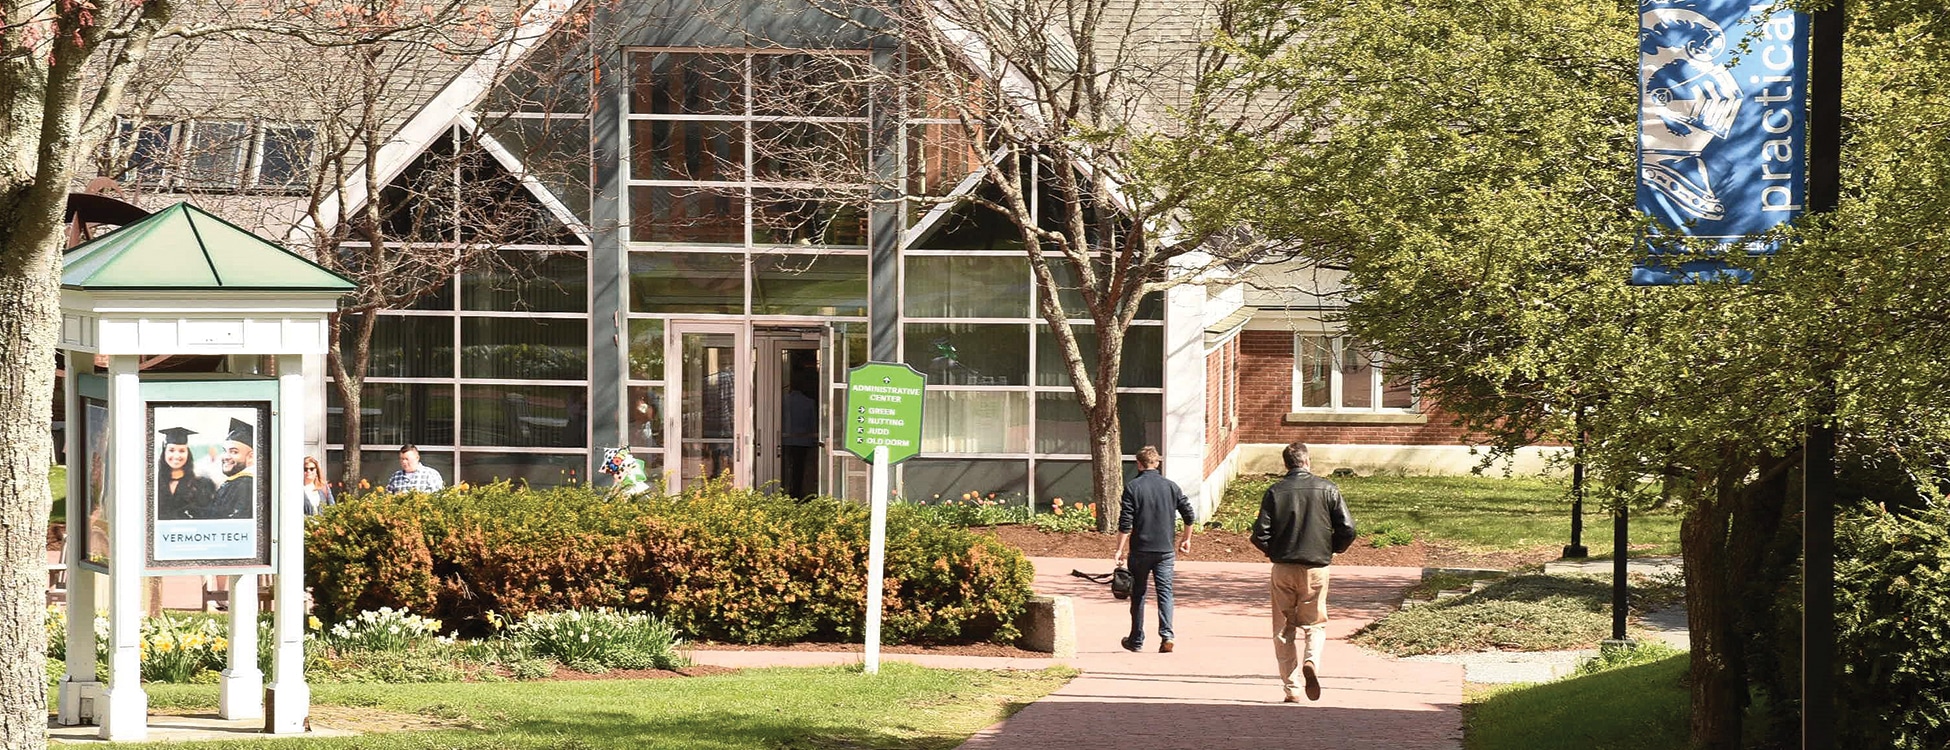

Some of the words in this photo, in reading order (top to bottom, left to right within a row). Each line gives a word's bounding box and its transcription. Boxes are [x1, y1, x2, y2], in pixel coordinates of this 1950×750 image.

[852, 385, 920, 395] ADMINISTRATIVE
[868, 418, 904, 426] NUTTING
[163, 533, 217, 542] VERMONT
[221, 533, 248, 541] TECH
